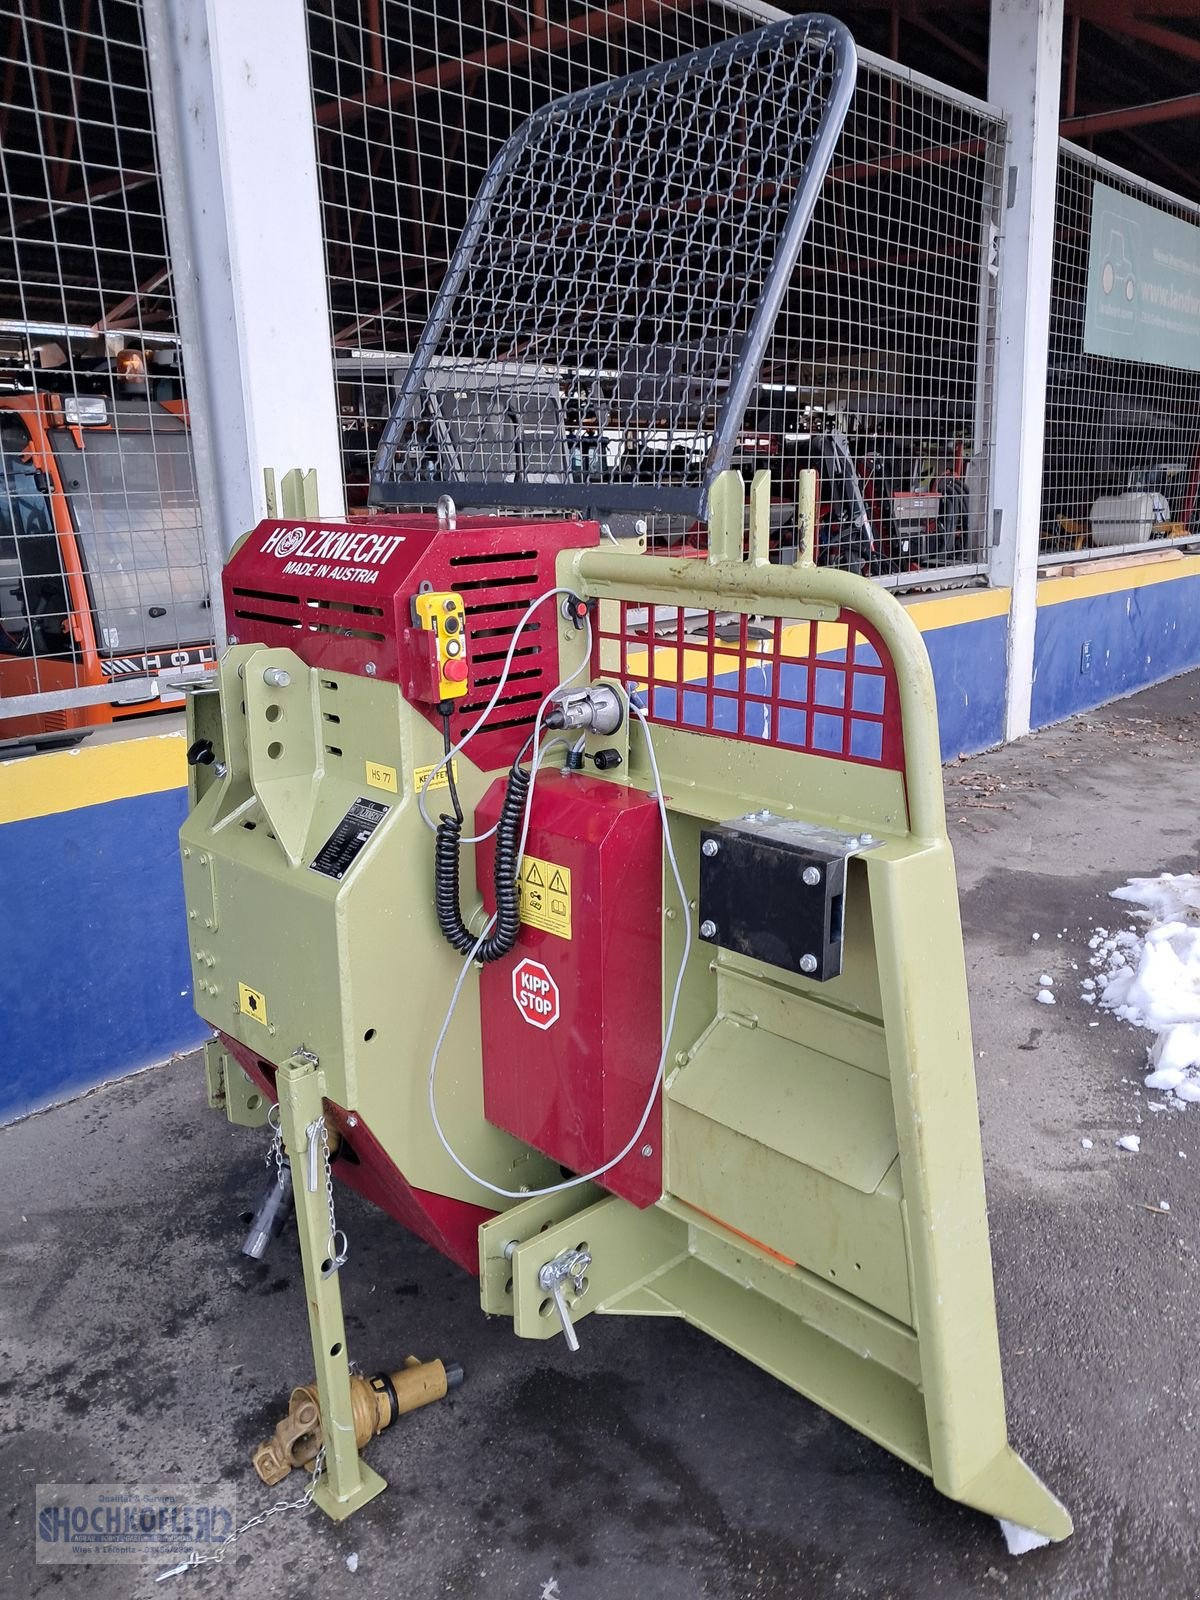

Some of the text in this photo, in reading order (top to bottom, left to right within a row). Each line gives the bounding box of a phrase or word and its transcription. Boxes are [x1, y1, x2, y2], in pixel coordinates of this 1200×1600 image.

[260, 527, 406, 565] HOLZKNECHT
[282, 561, 379, 584] MADE IN AUSTRIA
[371, 769, 391, 784] HS 77
[521, 971, 550, 996] KIPP
[520, 990, 552, 1015] STOP
